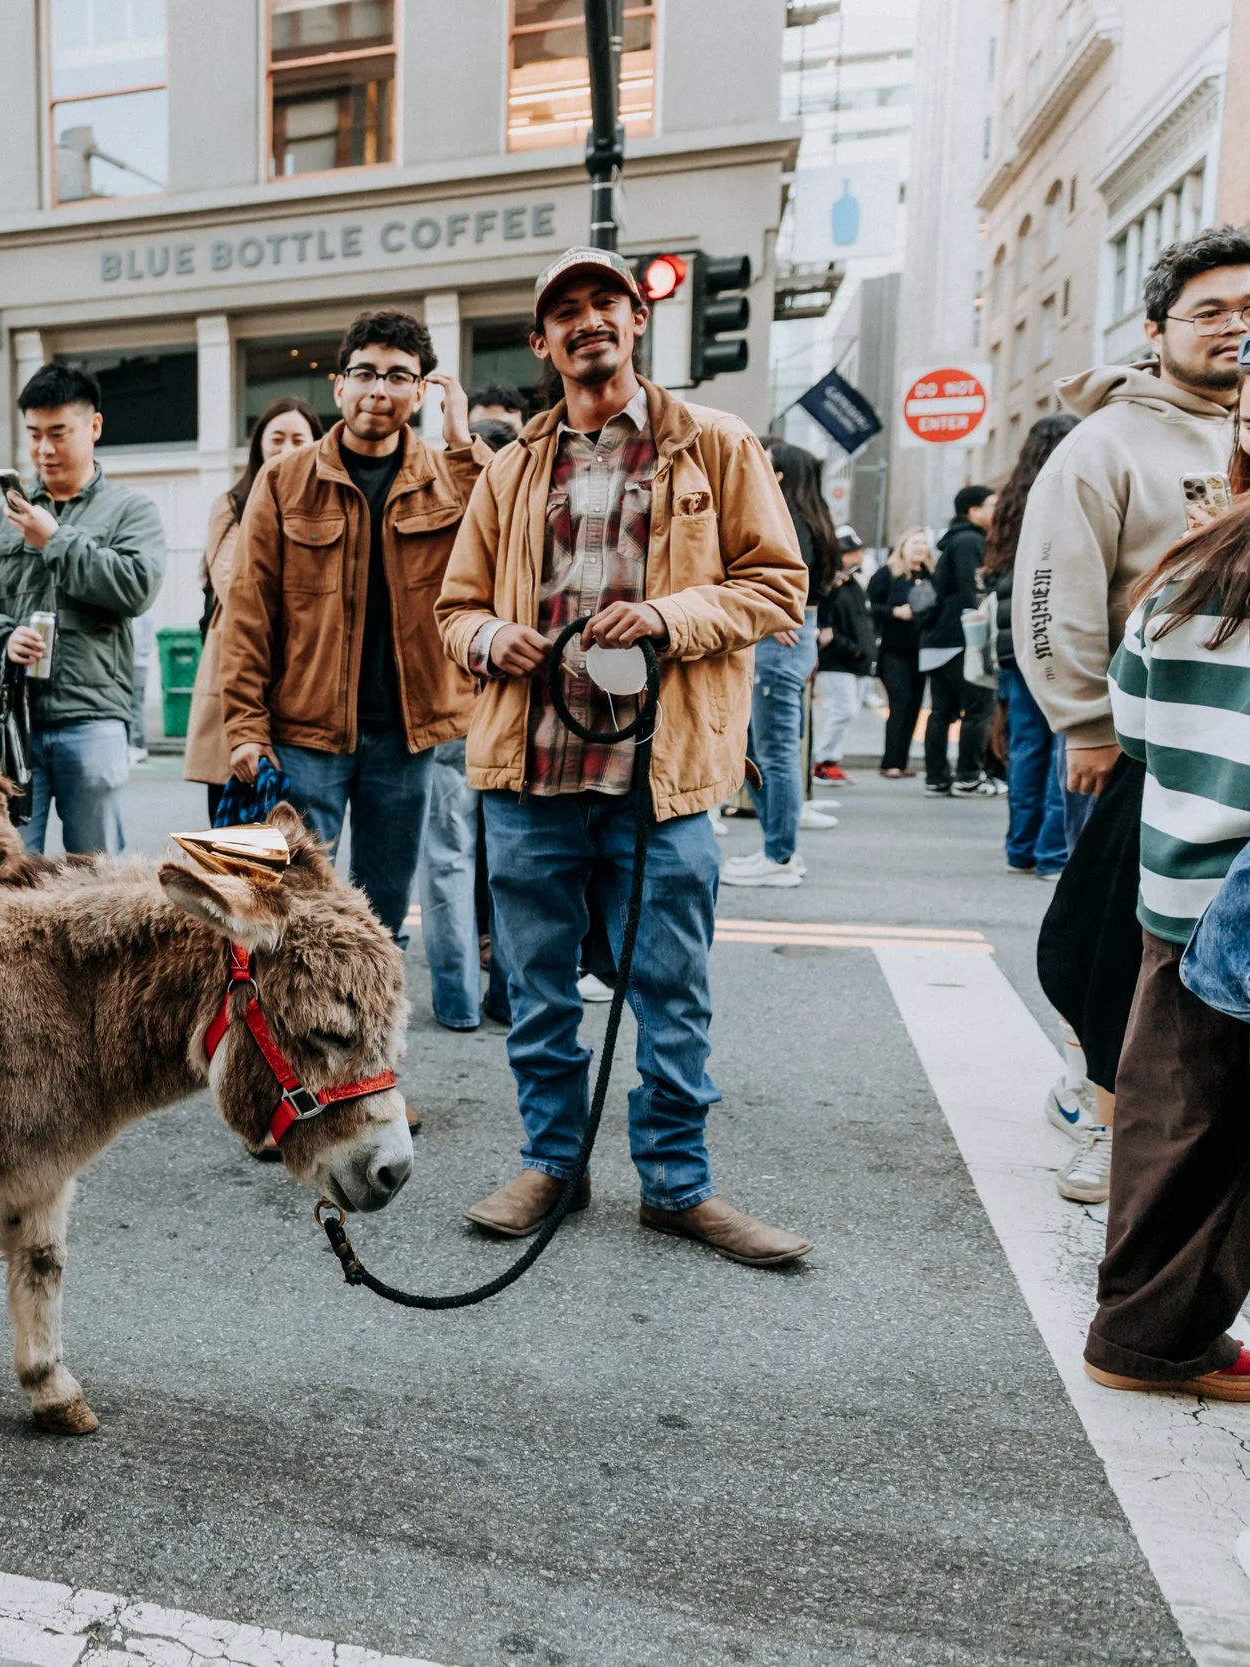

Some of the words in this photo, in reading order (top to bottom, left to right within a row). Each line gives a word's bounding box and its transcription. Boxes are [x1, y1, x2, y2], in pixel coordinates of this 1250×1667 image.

[100, 242, 195, 282] BLUE
[209, 225, 363, 272] BOTTLE
[379, 202, 556, 254] COFFEE
[914, 381, 939, 399] DO
[944, 379, 977, 397] NOT
[917, 414, 970, 433] ENTER
